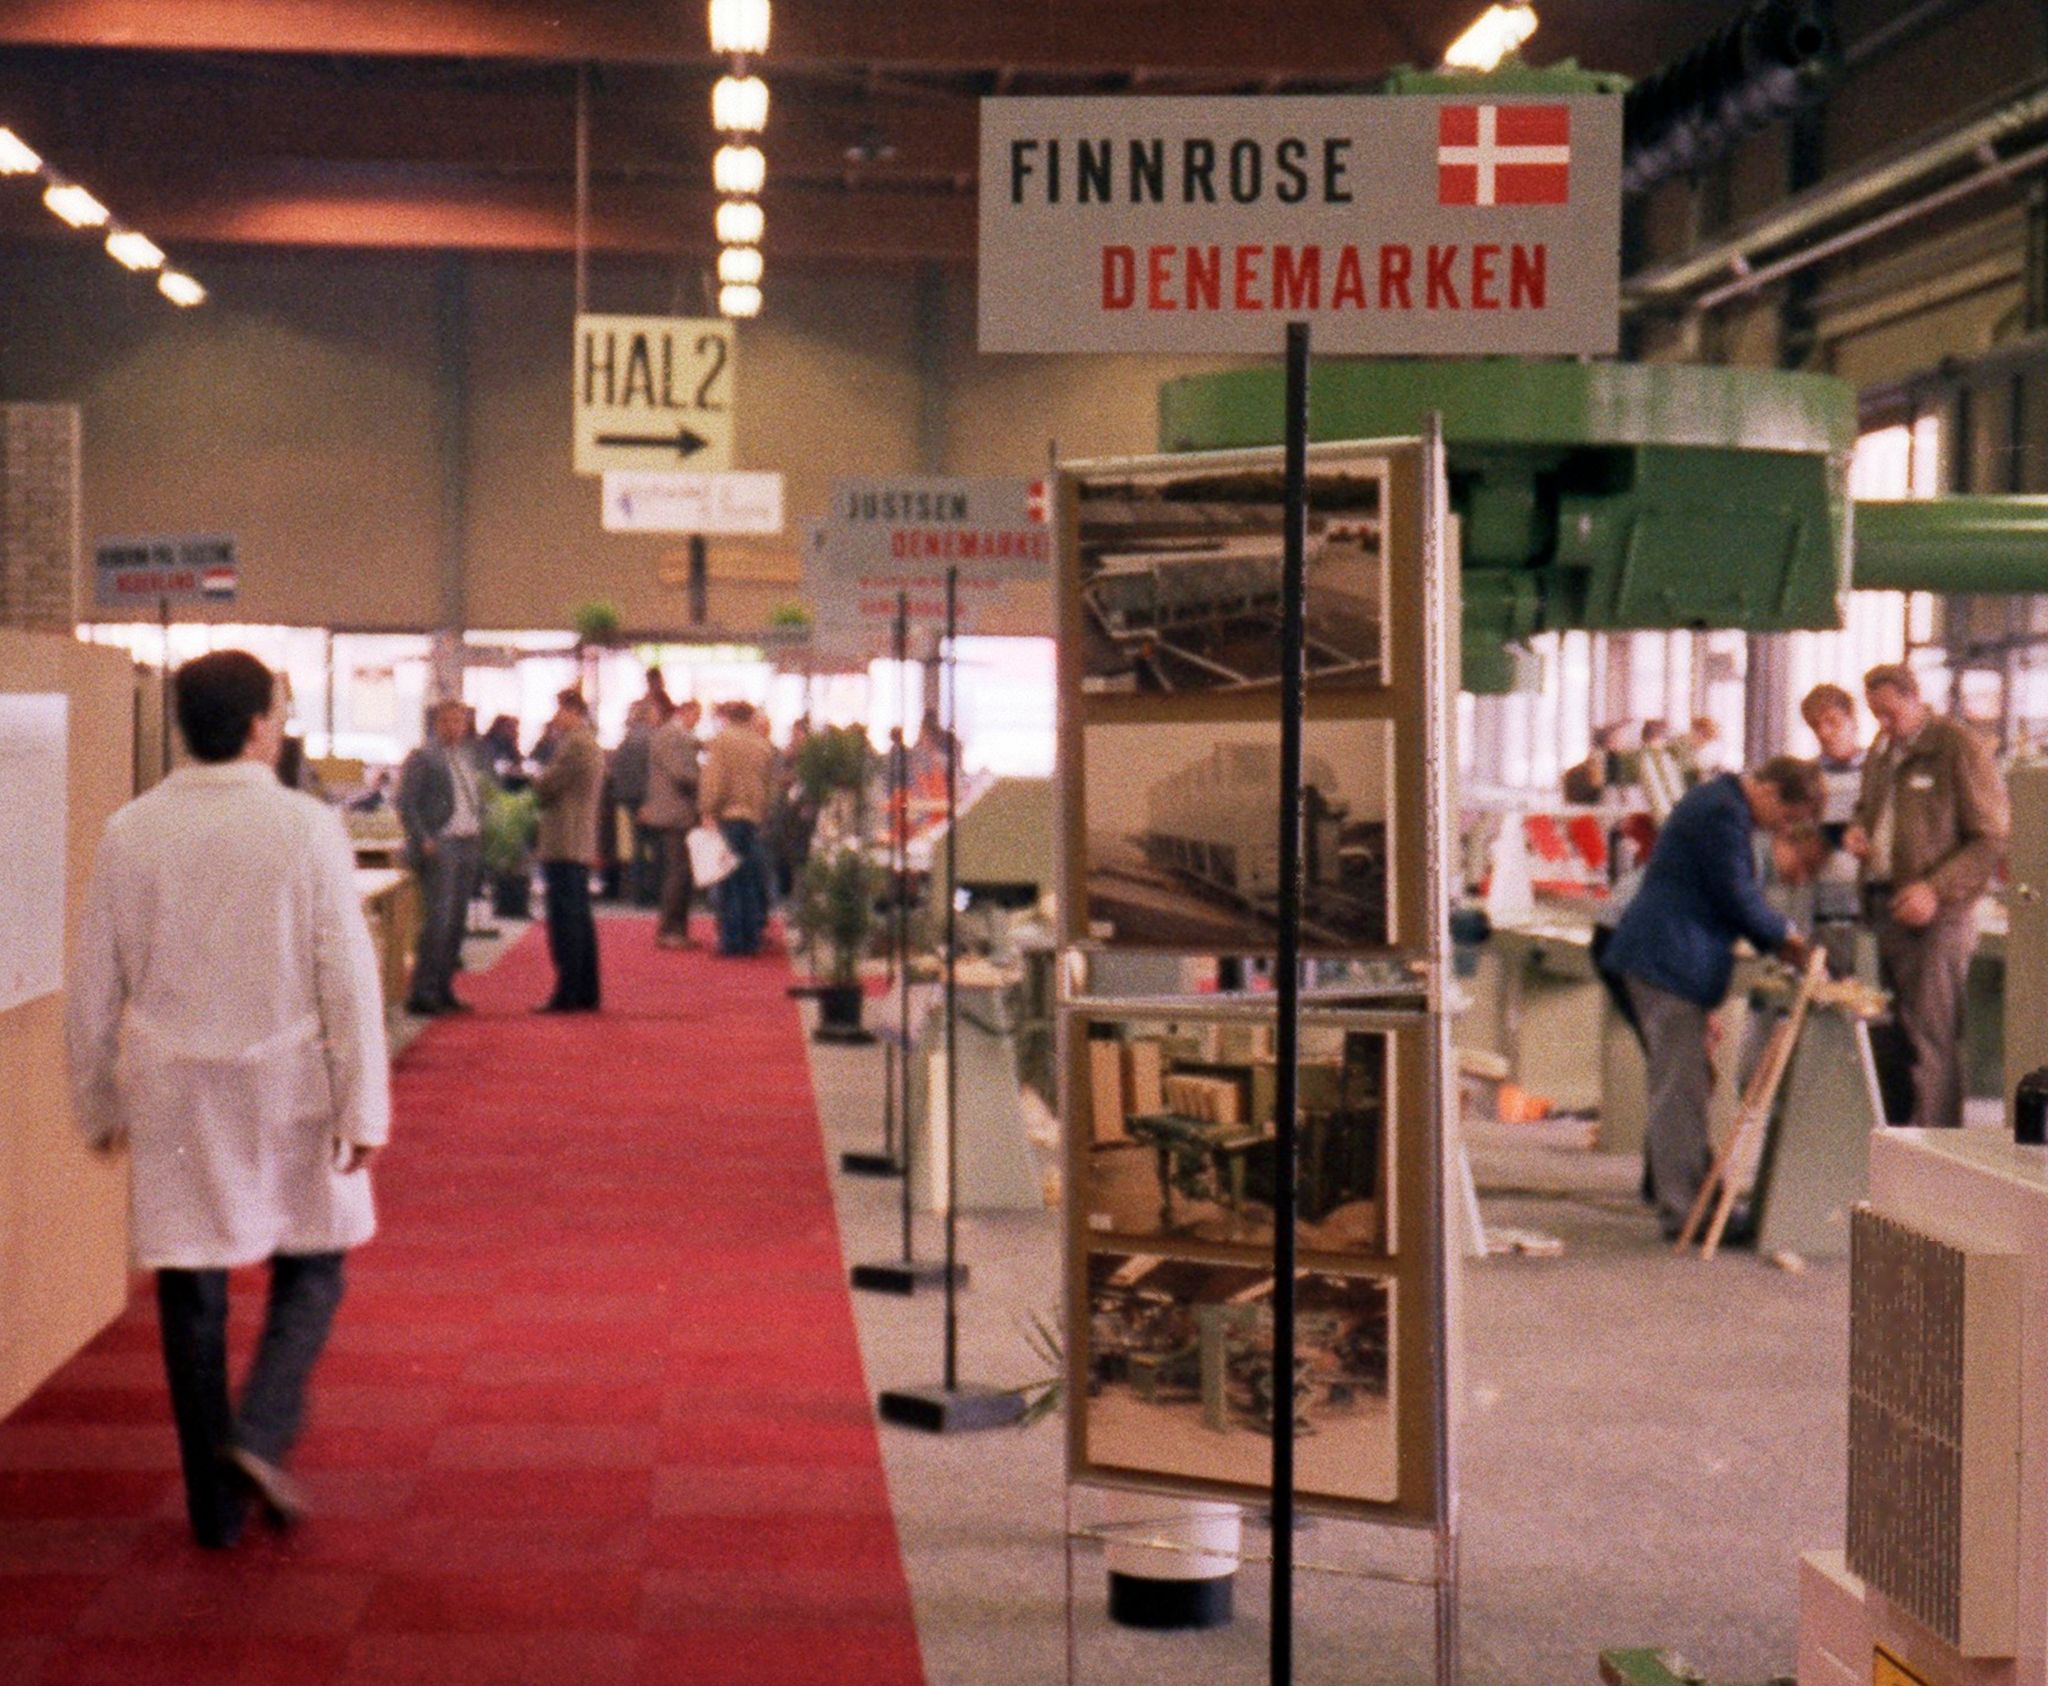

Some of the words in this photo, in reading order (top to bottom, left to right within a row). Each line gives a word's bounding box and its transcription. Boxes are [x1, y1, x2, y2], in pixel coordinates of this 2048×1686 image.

[1010, 138, 1354, 203] FINNROSE
[1101, 243, 1547, 311] DENEMARKEN
[847, 491, 967, 522] JUSTSEN
